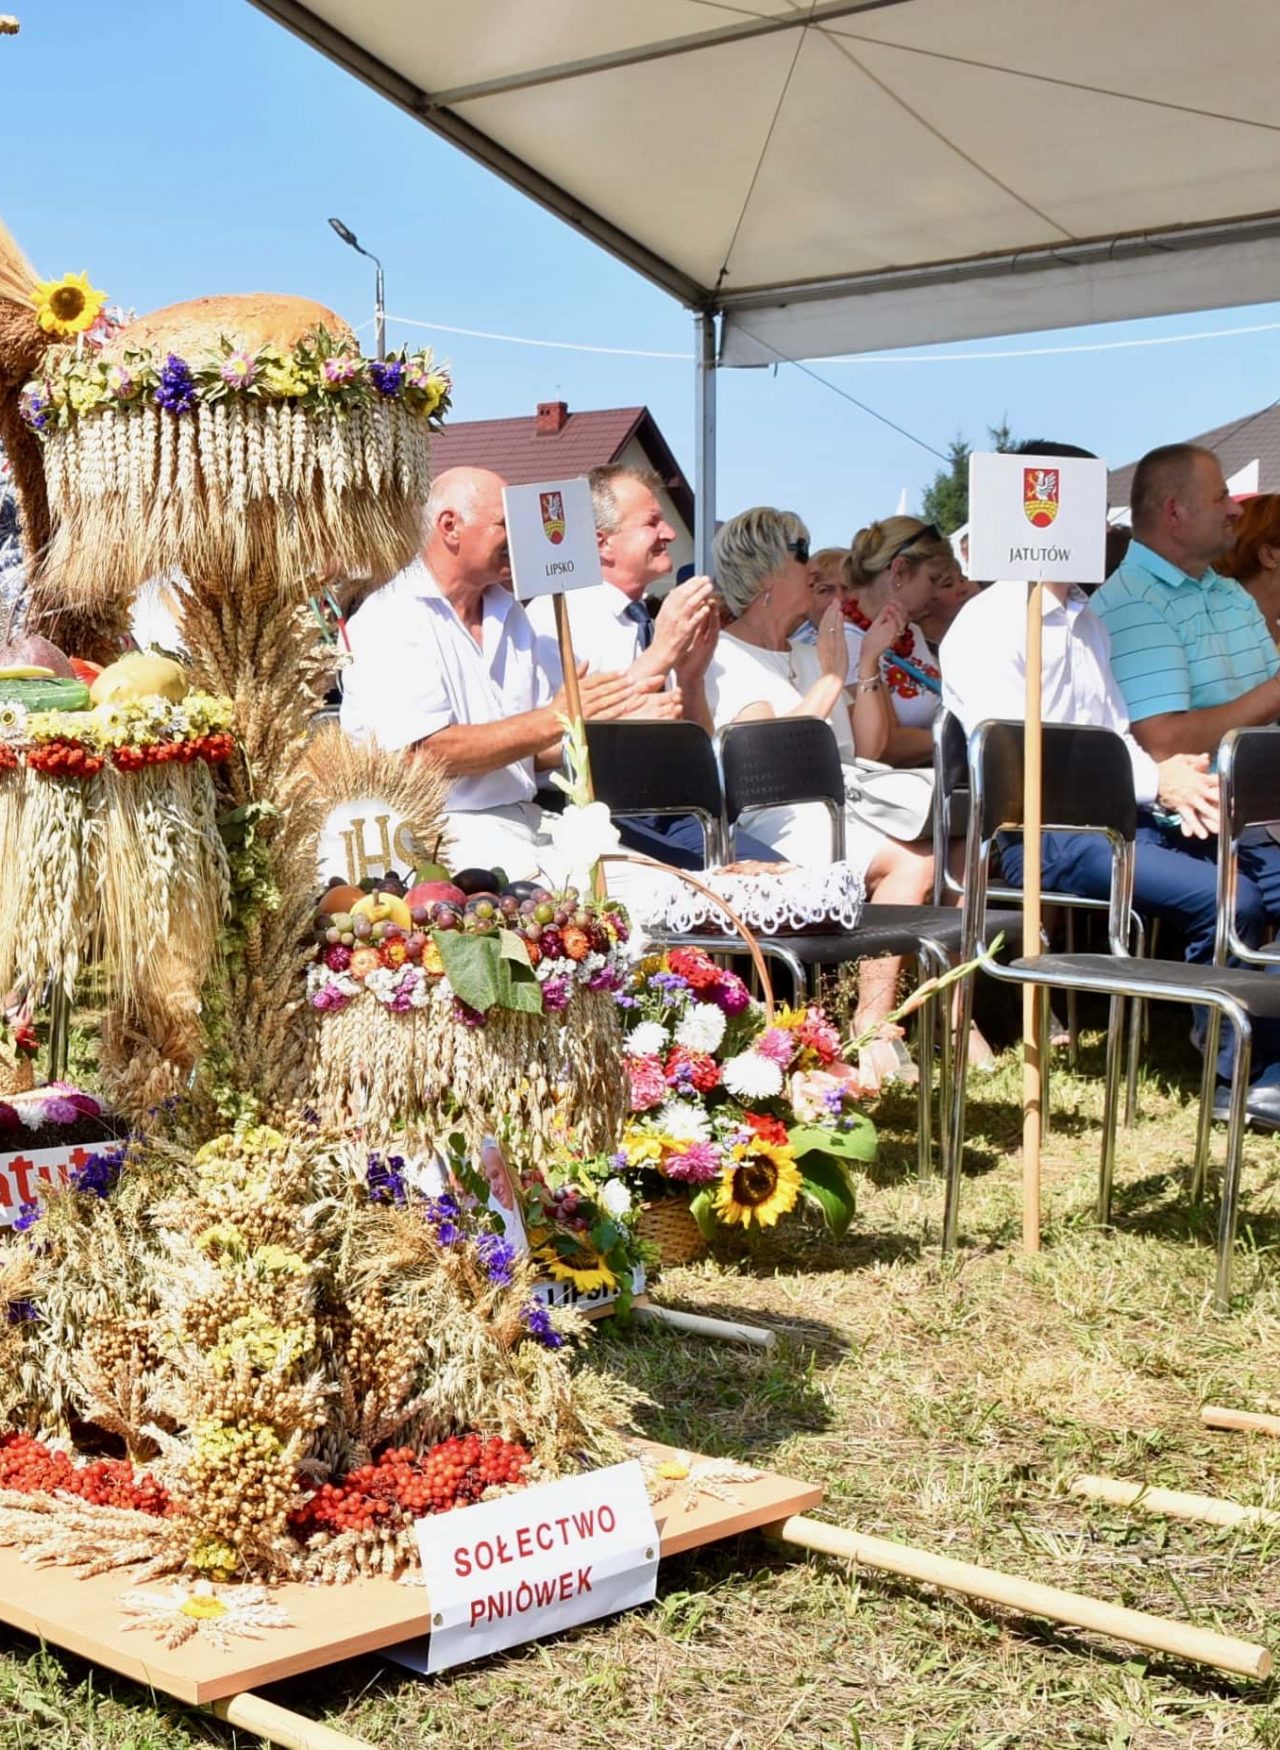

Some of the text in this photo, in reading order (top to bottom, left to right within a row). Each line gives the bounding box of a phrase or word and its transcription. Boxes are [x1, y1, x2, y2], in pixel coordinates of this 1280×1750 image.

[545, 560, 575, 576] LIPSKO
[1009, 545, 1071, 562] JATUTÓW
[453, 1505, 616, 1578] SOŁECTWO
[470, 1565, 594, 1629] PNIÓWEK
